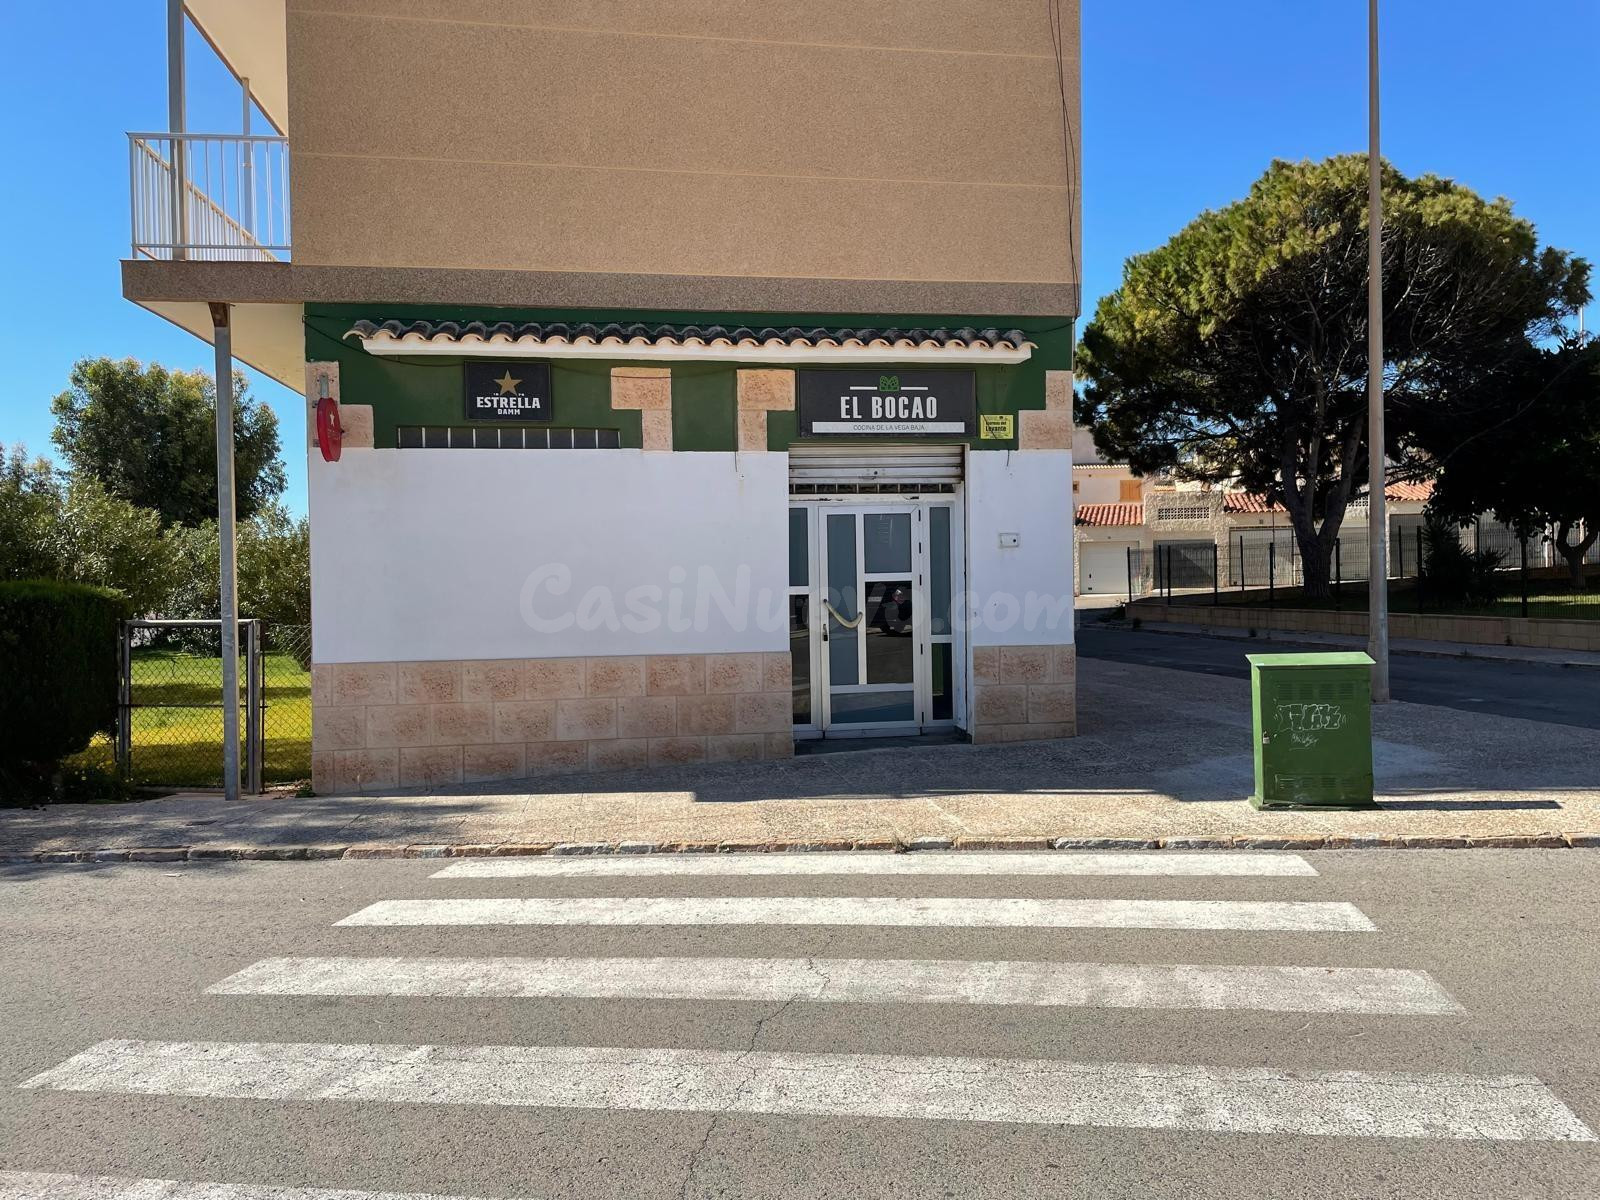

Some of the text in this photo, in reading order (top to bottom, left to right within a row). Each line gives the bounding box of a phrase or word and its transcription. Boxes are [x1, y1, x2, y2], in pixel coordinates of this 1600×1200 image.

[476, 396, 541, 409] ESTRELLA
[840, 396, 937, 419] EL BOCAO
